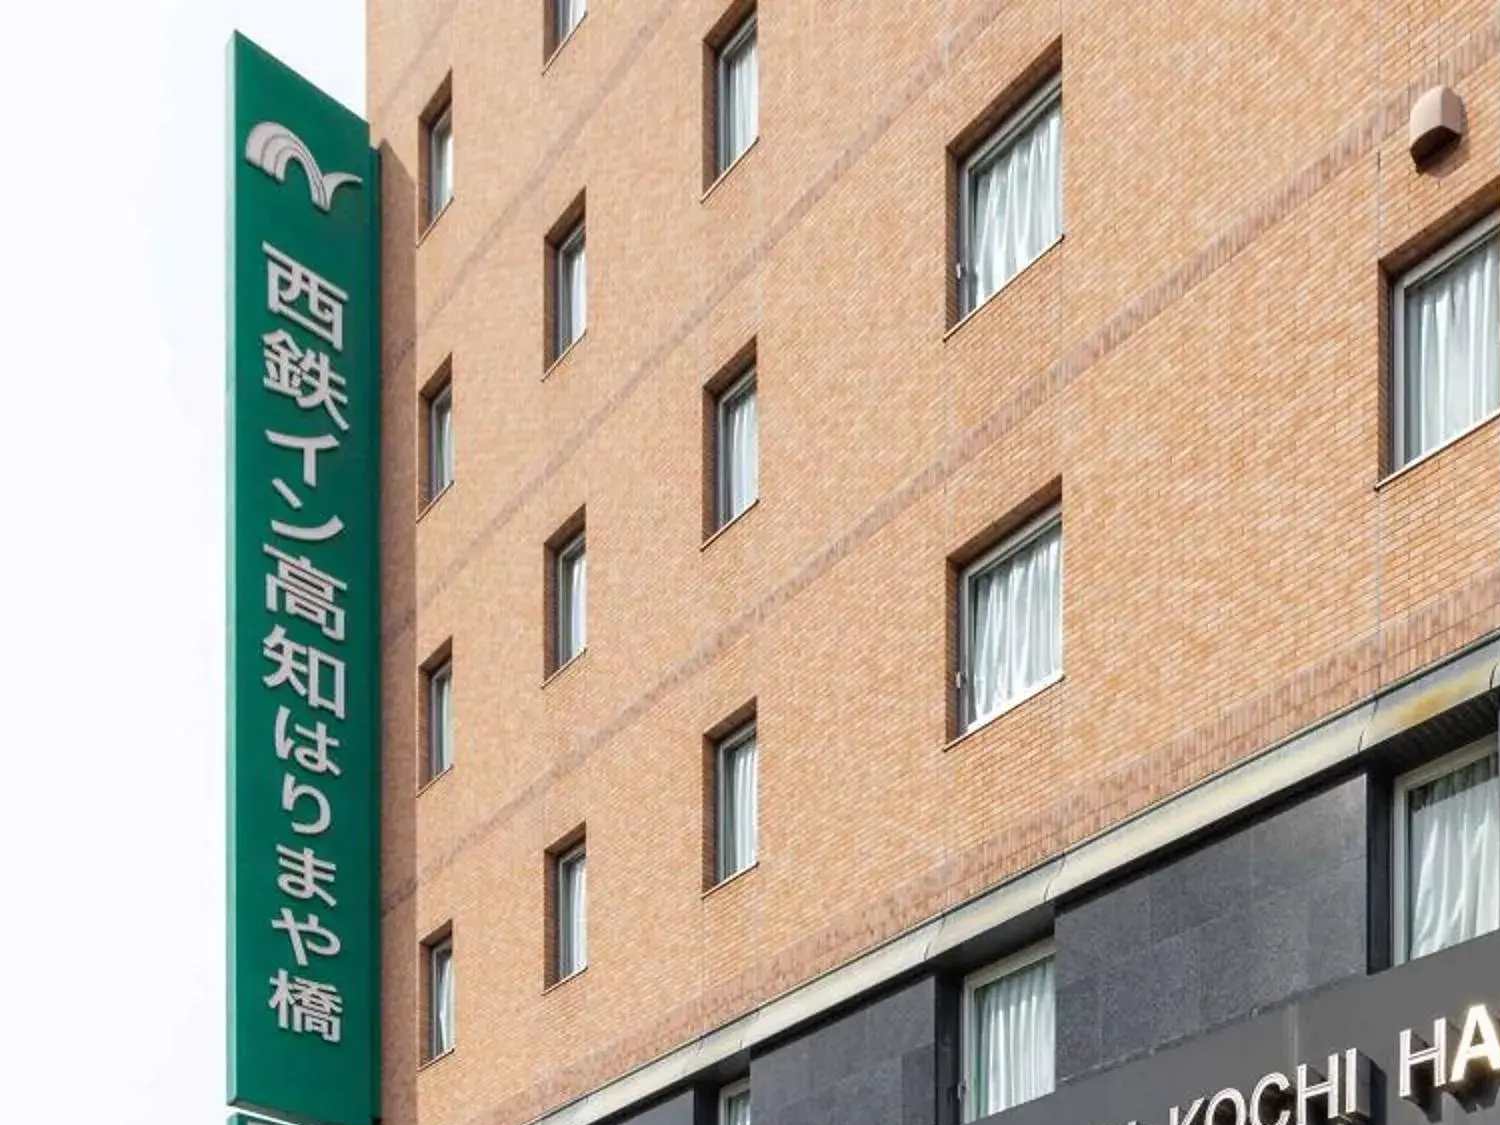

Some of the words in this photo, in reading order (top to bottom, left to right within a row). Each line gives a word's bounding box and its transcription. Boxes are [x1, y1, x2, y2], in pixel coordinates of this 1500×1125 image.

[262, 240, 349, 1043] 西鉄イン高知はりまや橋
